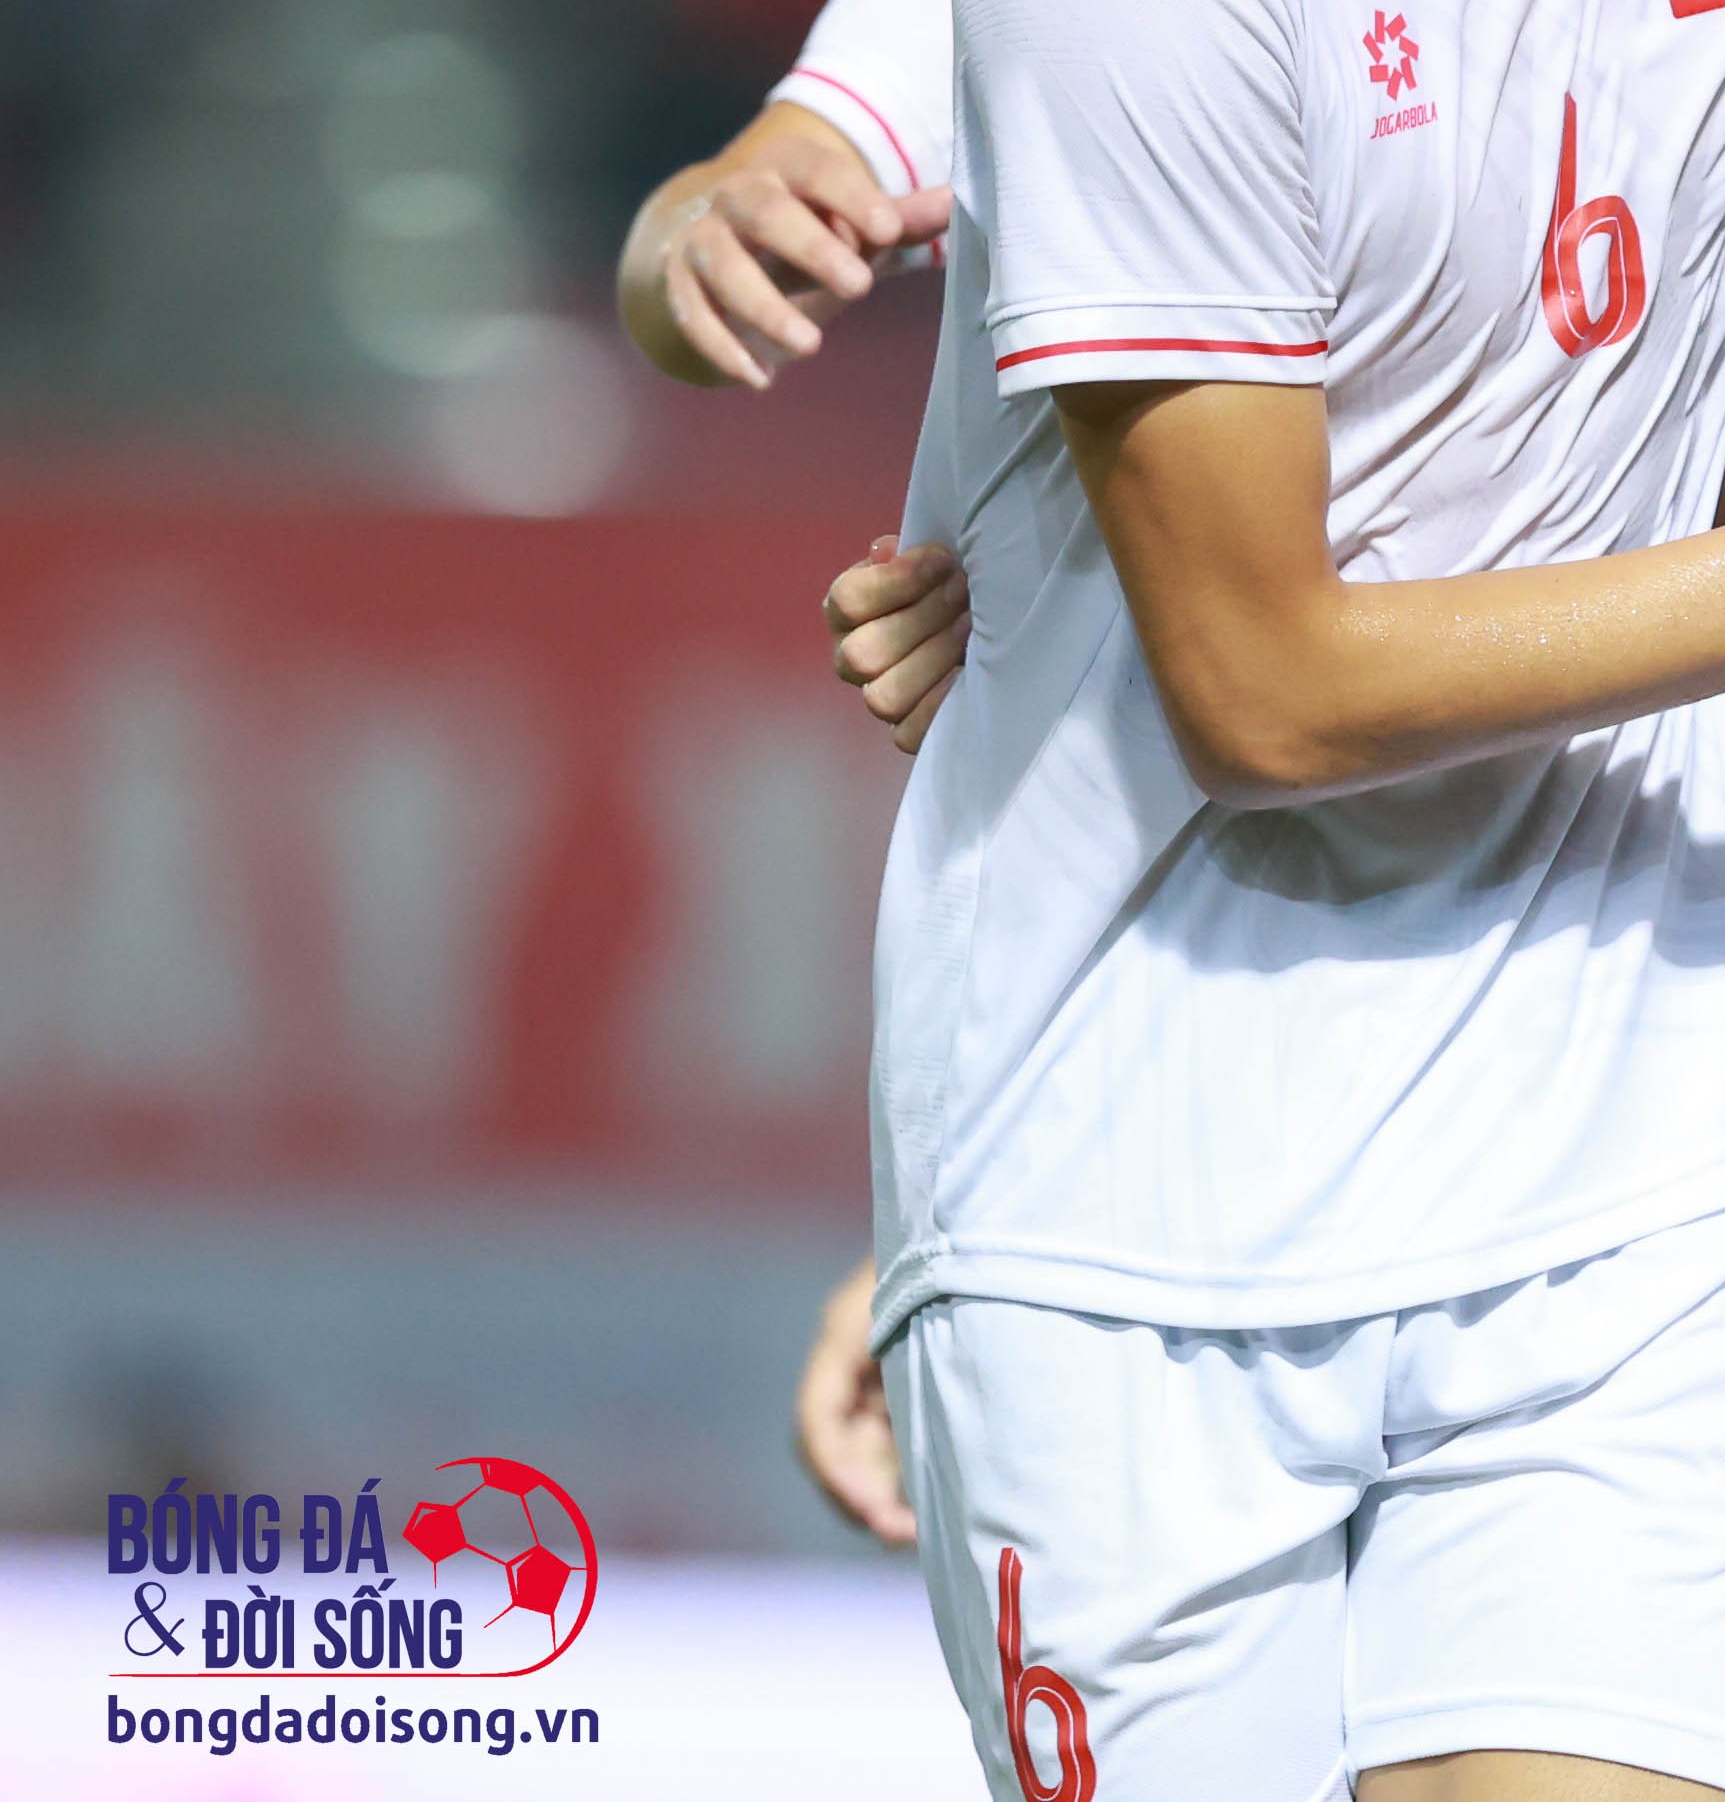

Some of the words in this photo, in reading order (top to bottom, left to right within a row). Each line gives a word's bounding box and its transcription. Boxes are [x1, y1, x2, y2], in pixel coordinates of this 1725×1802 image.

[1369, 101, 1438, 139] JOGARBOLA
[1541, 91, 1646, 359] 6
[998, 1547, 1096, 1802] 6
